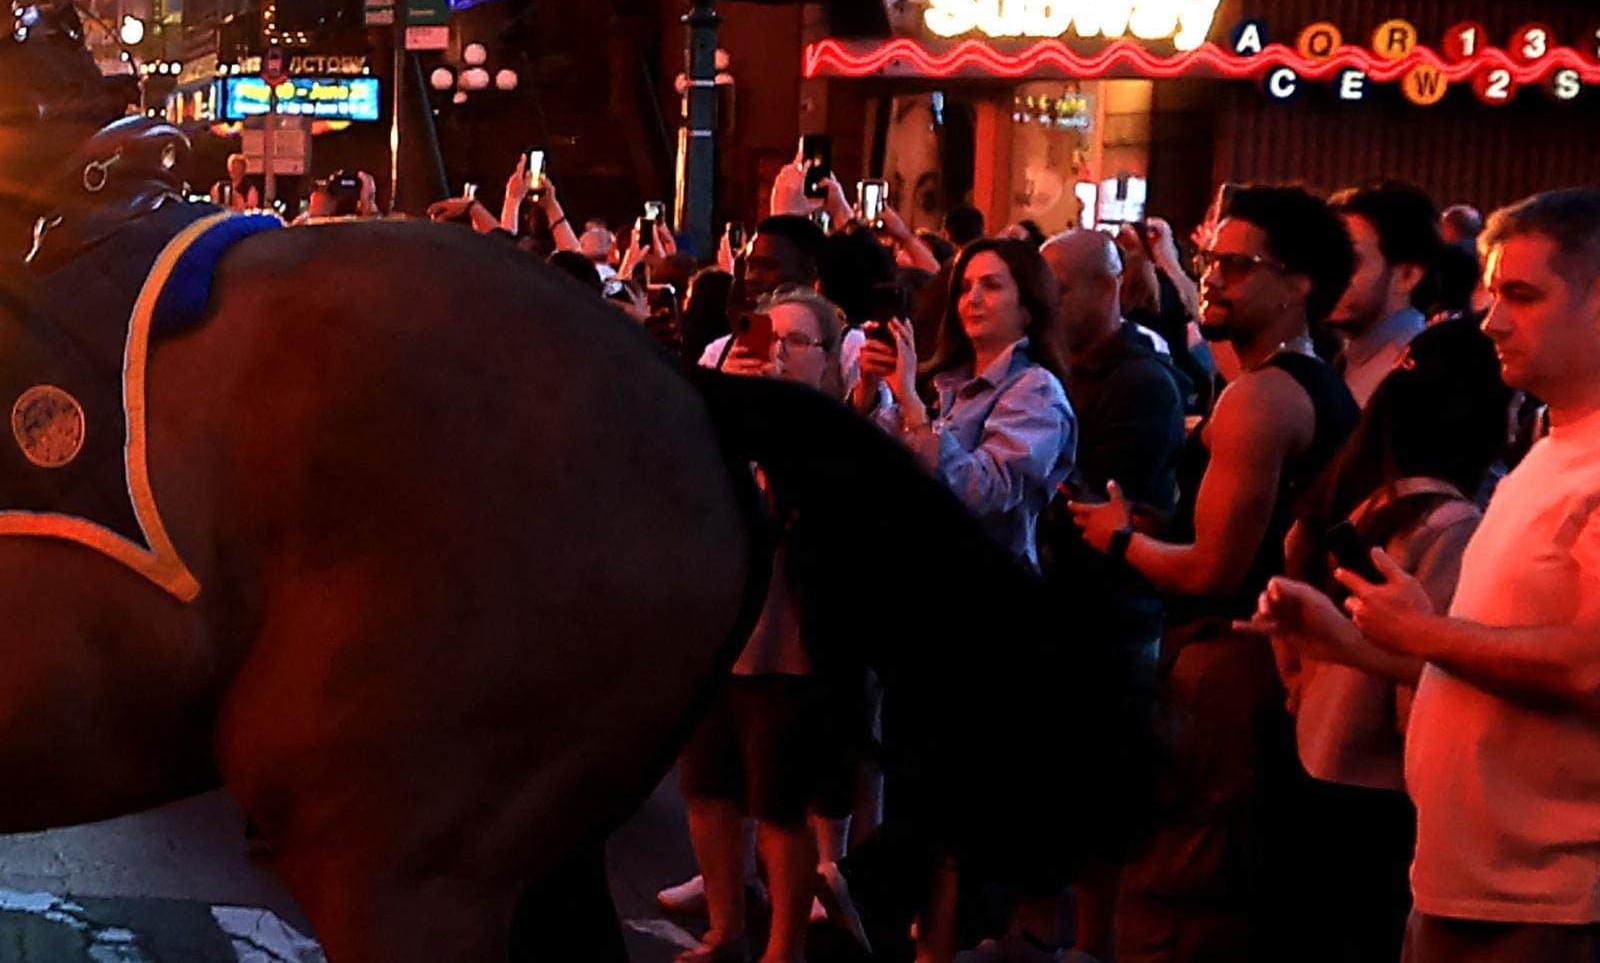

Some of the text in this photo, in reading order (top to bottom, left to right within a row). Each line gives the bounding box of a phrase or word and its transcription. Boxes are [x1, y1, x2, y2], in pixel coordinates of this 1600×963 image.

[1235, 24, 1546, 58] A Q R 1 3
[1270, 68, 1580, 99] C E W 2 S
